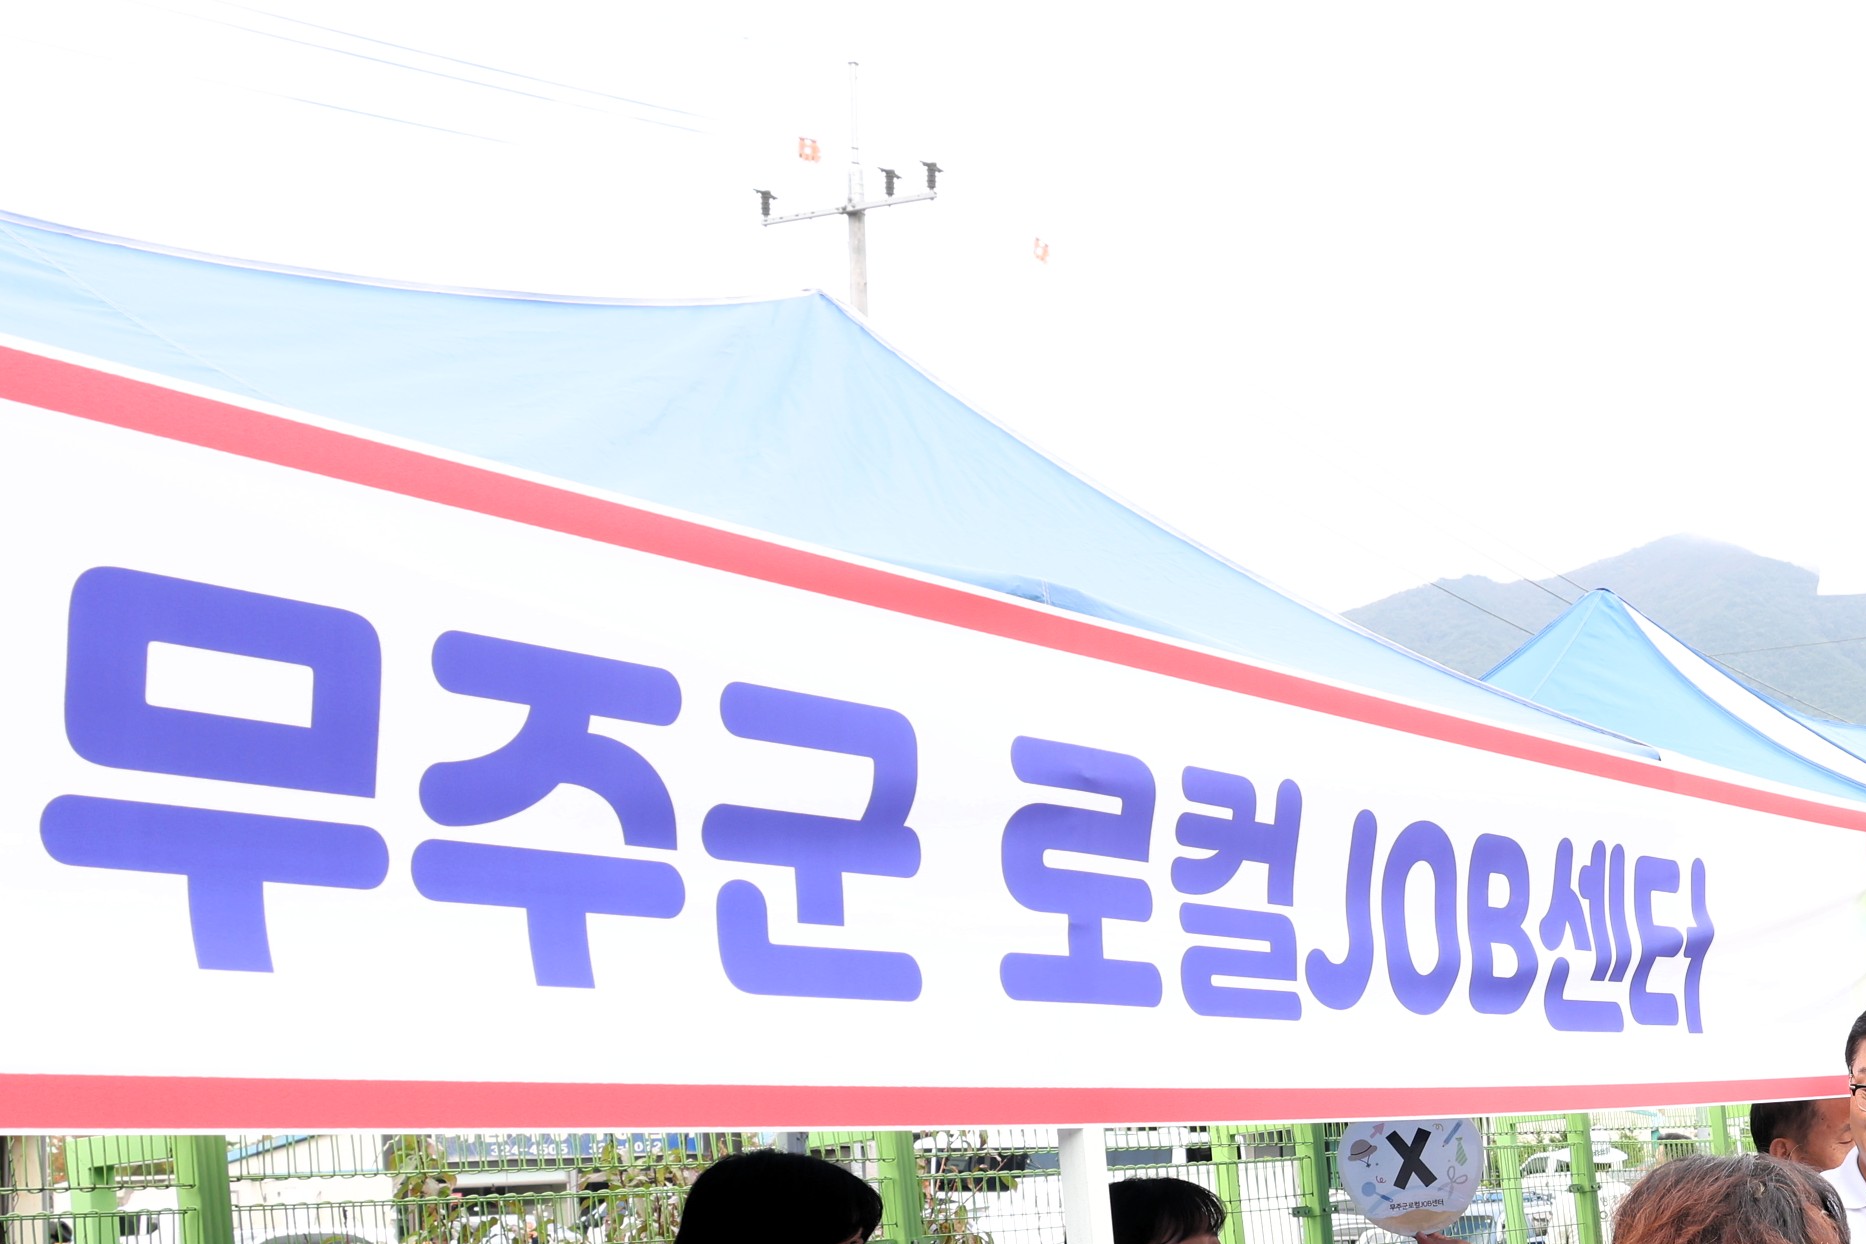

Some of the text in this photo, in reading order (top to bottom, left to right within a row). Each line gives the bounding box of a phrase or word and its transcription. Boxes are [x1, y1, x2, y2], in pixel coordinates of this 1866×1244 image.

[39, 565, 1714, 1034] 무주군 로컬JOB센터
[1385, 1127, 1438, 1190] X
[1389, 1198, 1445, 1212] 무주군로컬JOB센터
